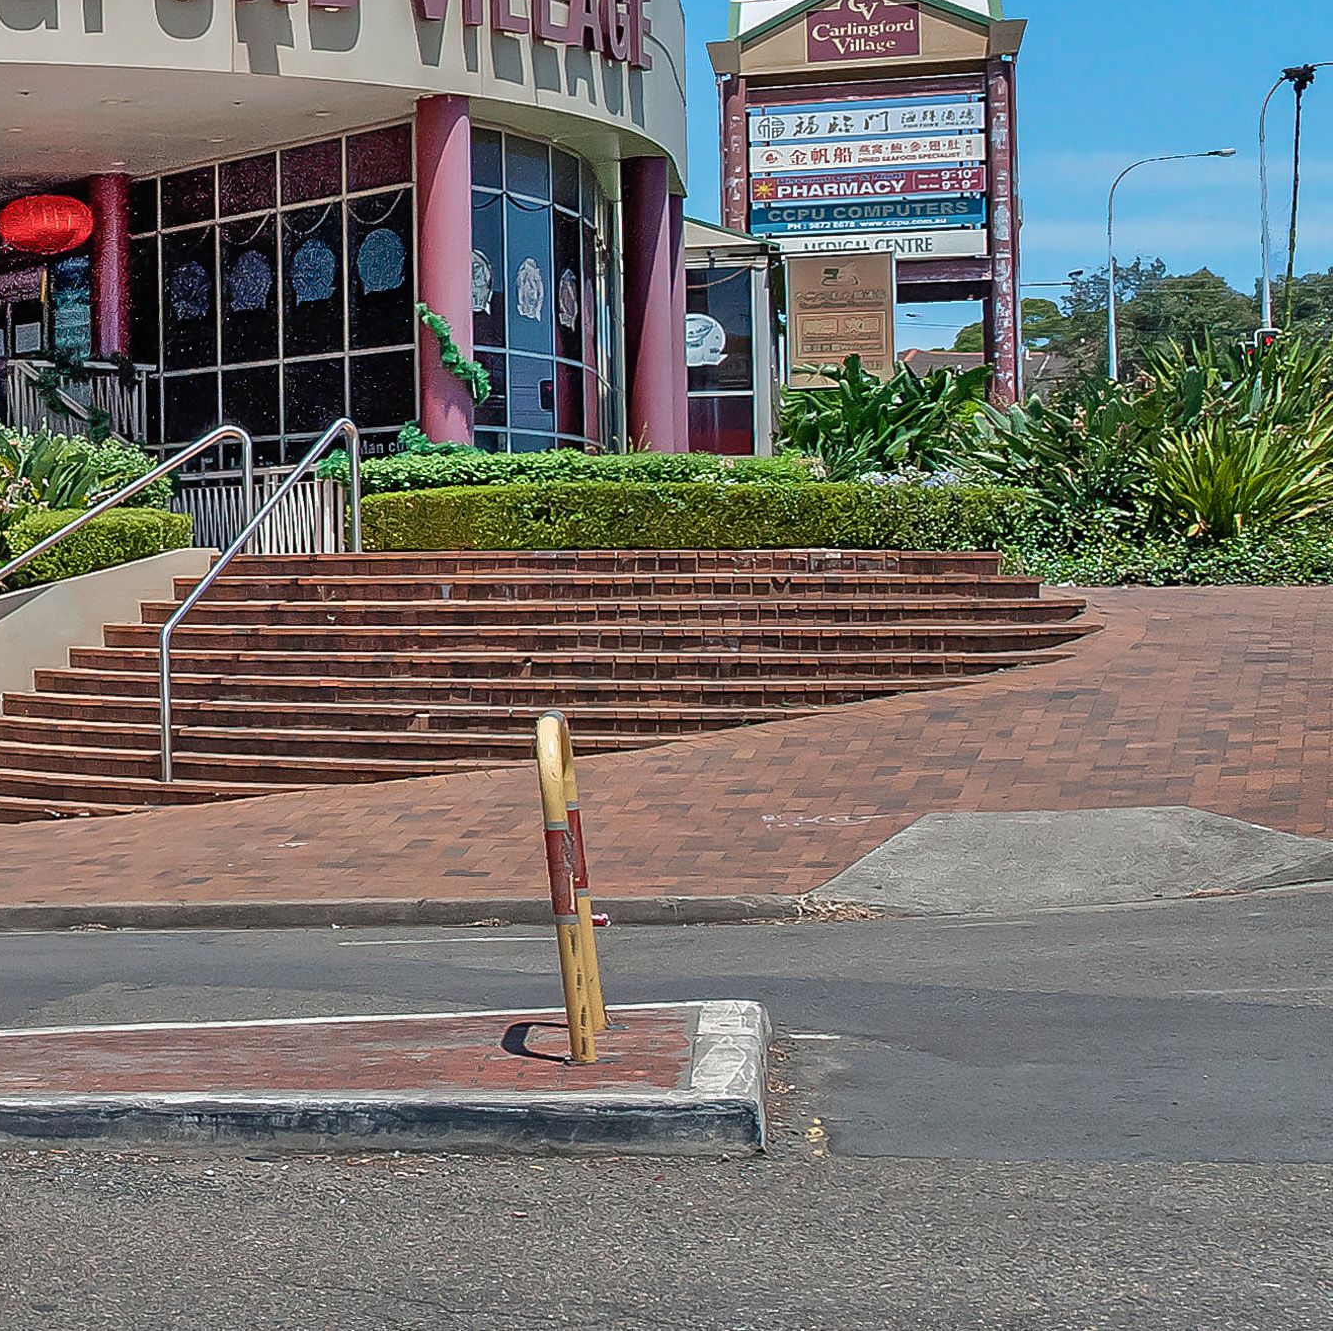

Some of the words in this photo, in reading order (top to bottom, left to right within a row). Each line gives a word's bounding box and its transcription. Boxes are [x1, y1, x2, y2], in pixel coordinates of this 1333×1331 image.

[812, 18, 914, 42] Carlingford
[832, 36, 896, 55] Village
[777, 179, 906, 198] PHARMACY
[767, 208, 826, 222] CCPU
[833, 201, 969, 219] COMPUTERS
